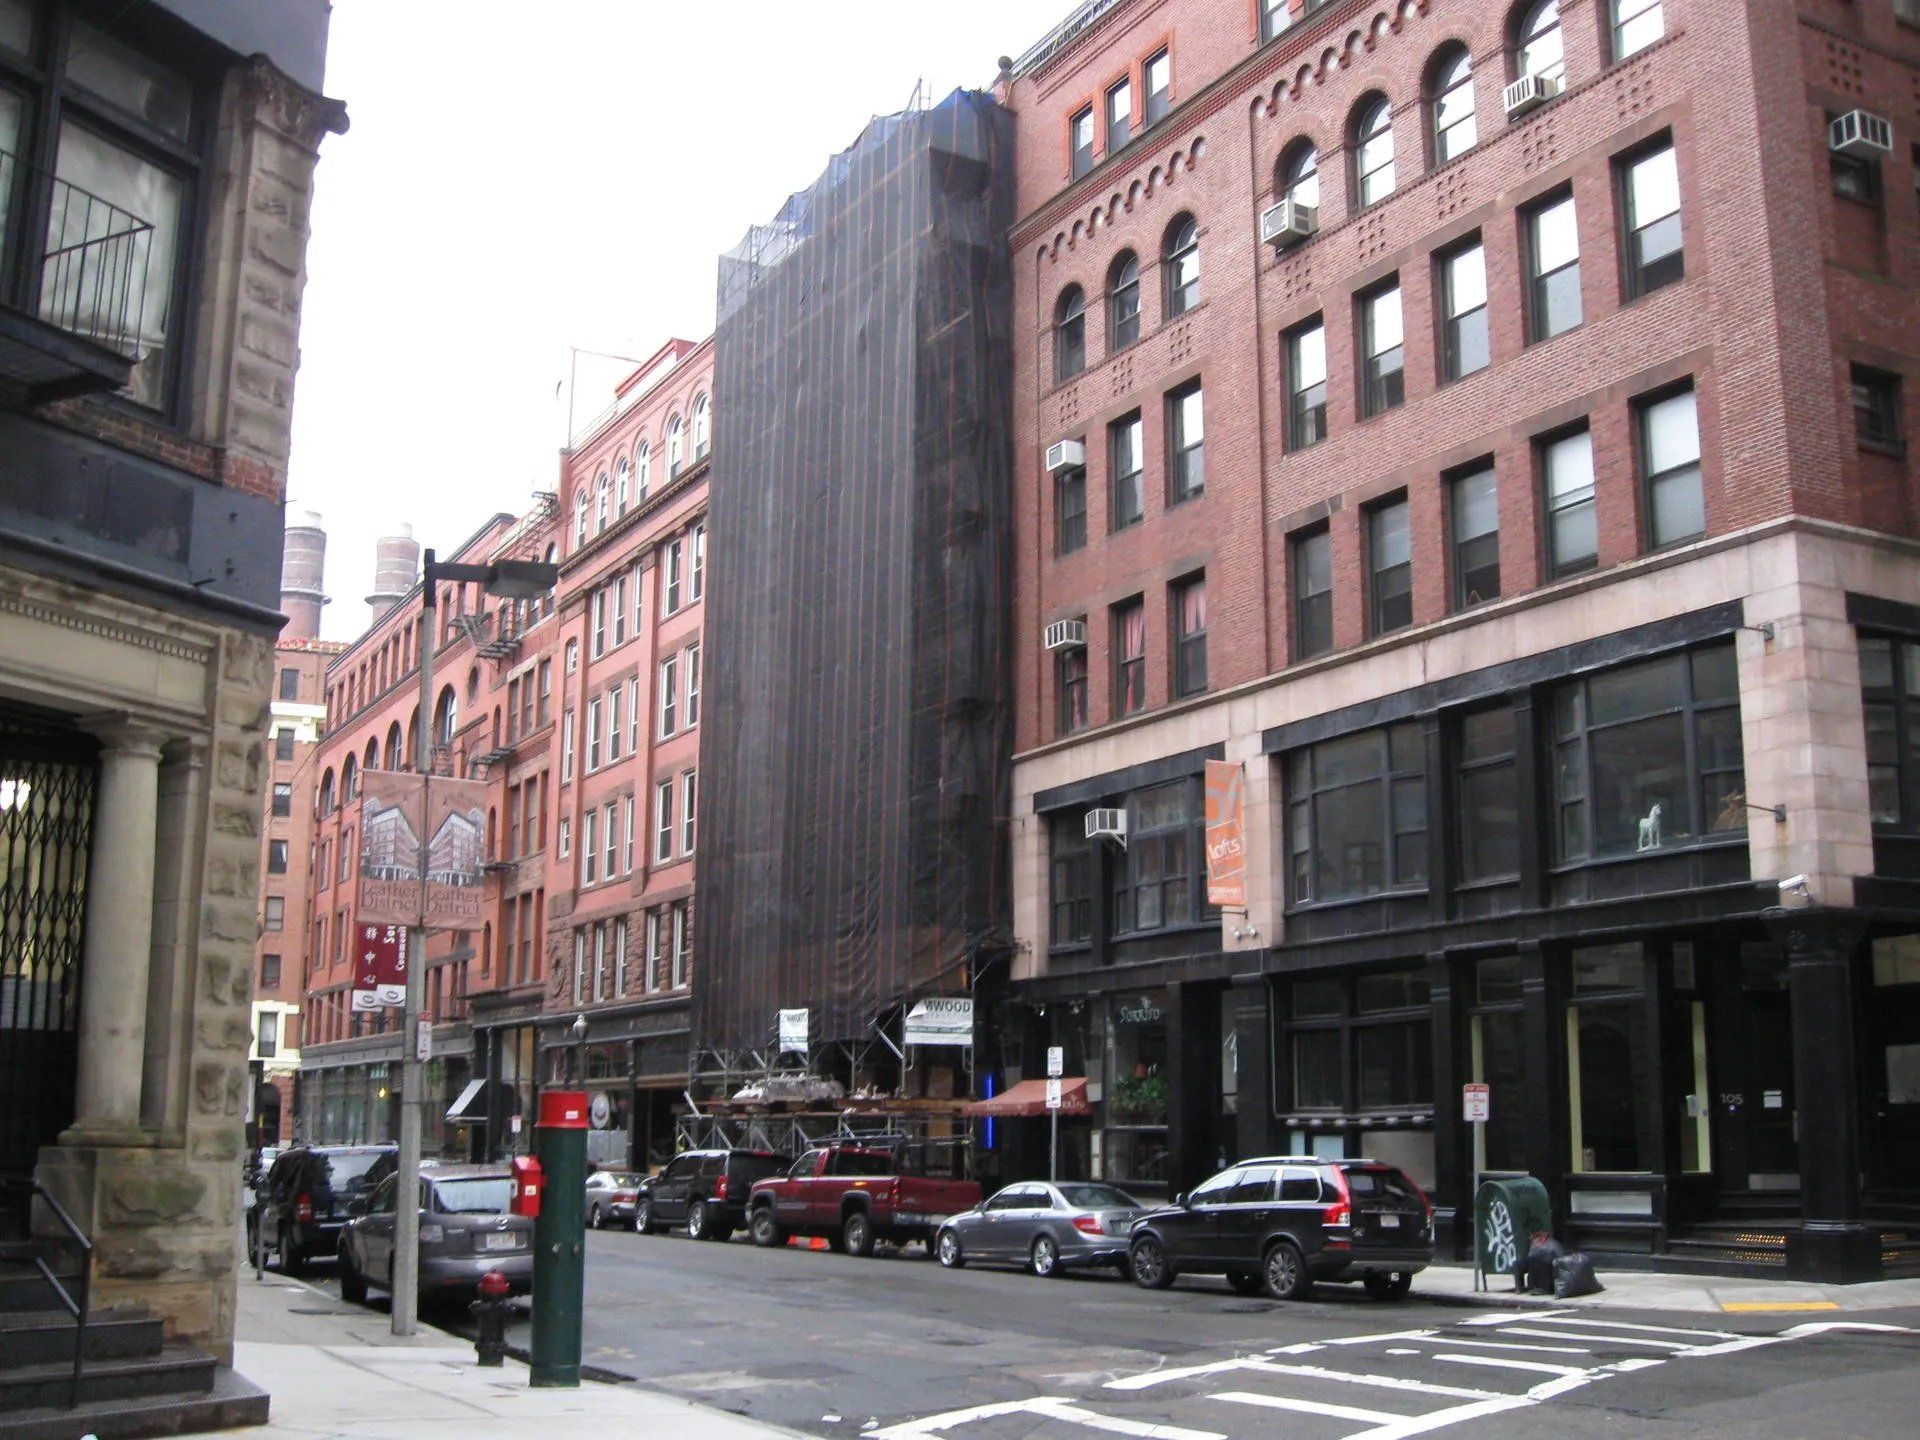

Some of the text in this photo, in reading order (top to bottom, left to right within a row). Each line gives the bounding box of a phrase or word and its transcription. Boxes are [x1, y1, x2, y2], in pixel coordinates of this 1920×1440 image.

[362, 881, 419, 898] Leather
[427, 885, 480, 903] Leather
[361, 894, 418, 911] District
[426, 899, 480, 915] District
[1720, 1093, 1744, 1105] 105
